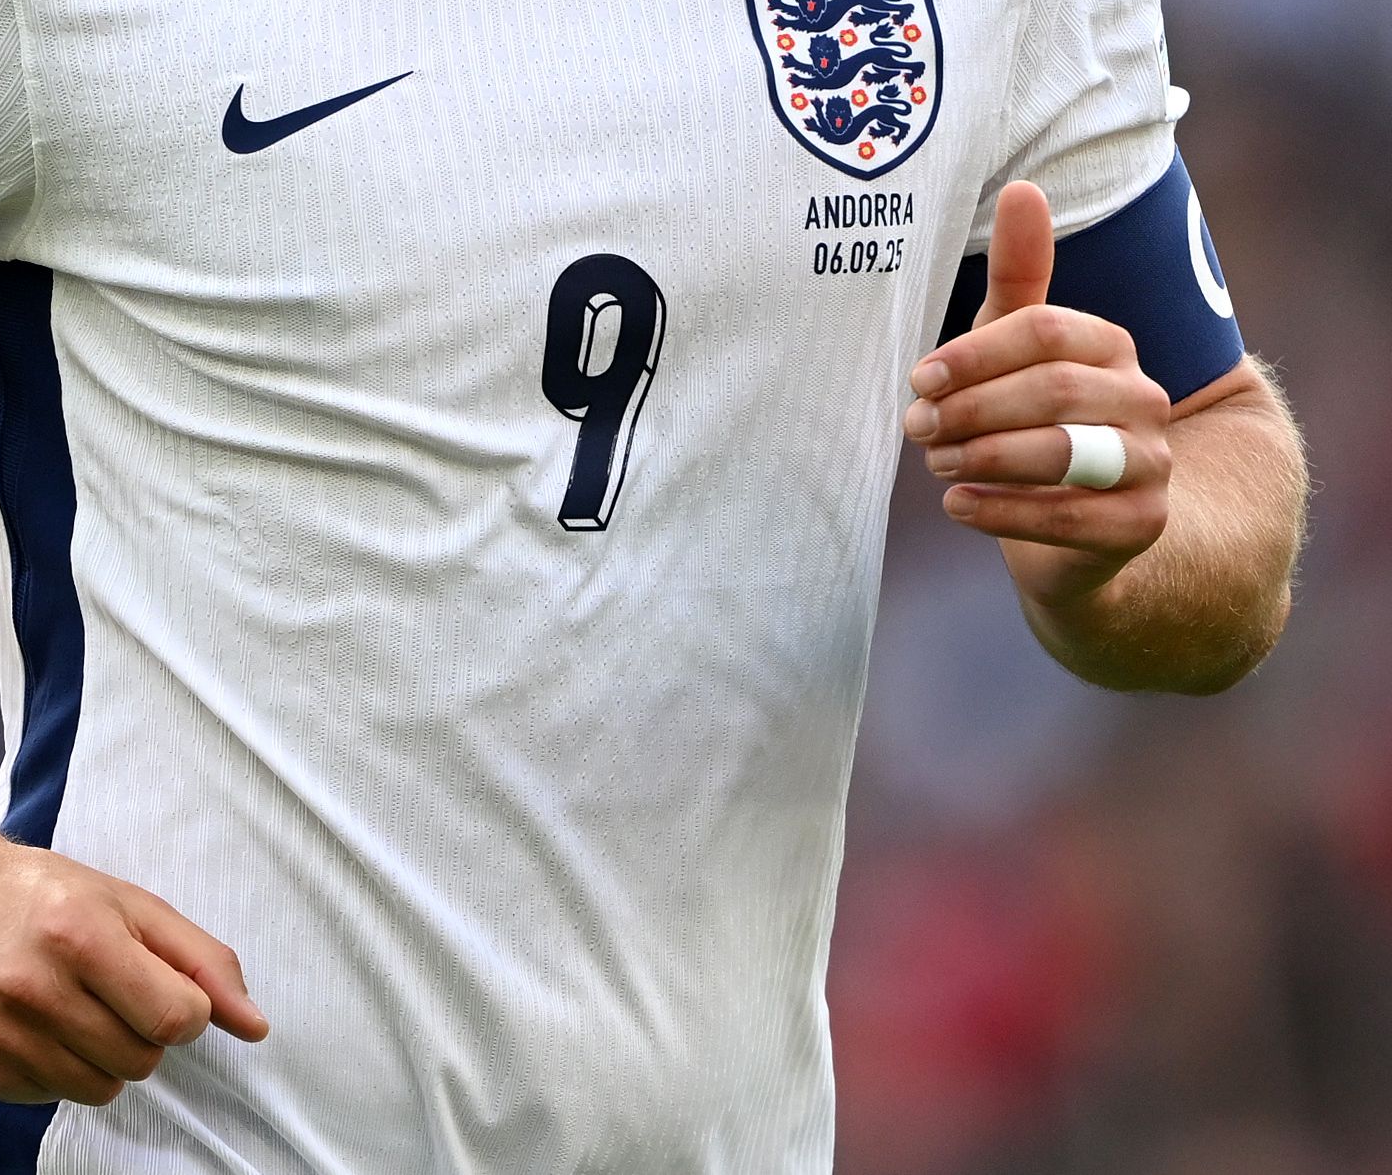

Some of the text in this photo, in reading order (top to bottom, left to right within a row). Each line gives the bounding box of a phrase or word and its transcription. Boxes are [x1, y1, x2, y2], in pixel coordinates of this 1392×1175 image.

[804, 192, 914, 230] ANDORRA
[813, 237, 905, 275] 06.09.25
[541, 252, 667, 532] 9
